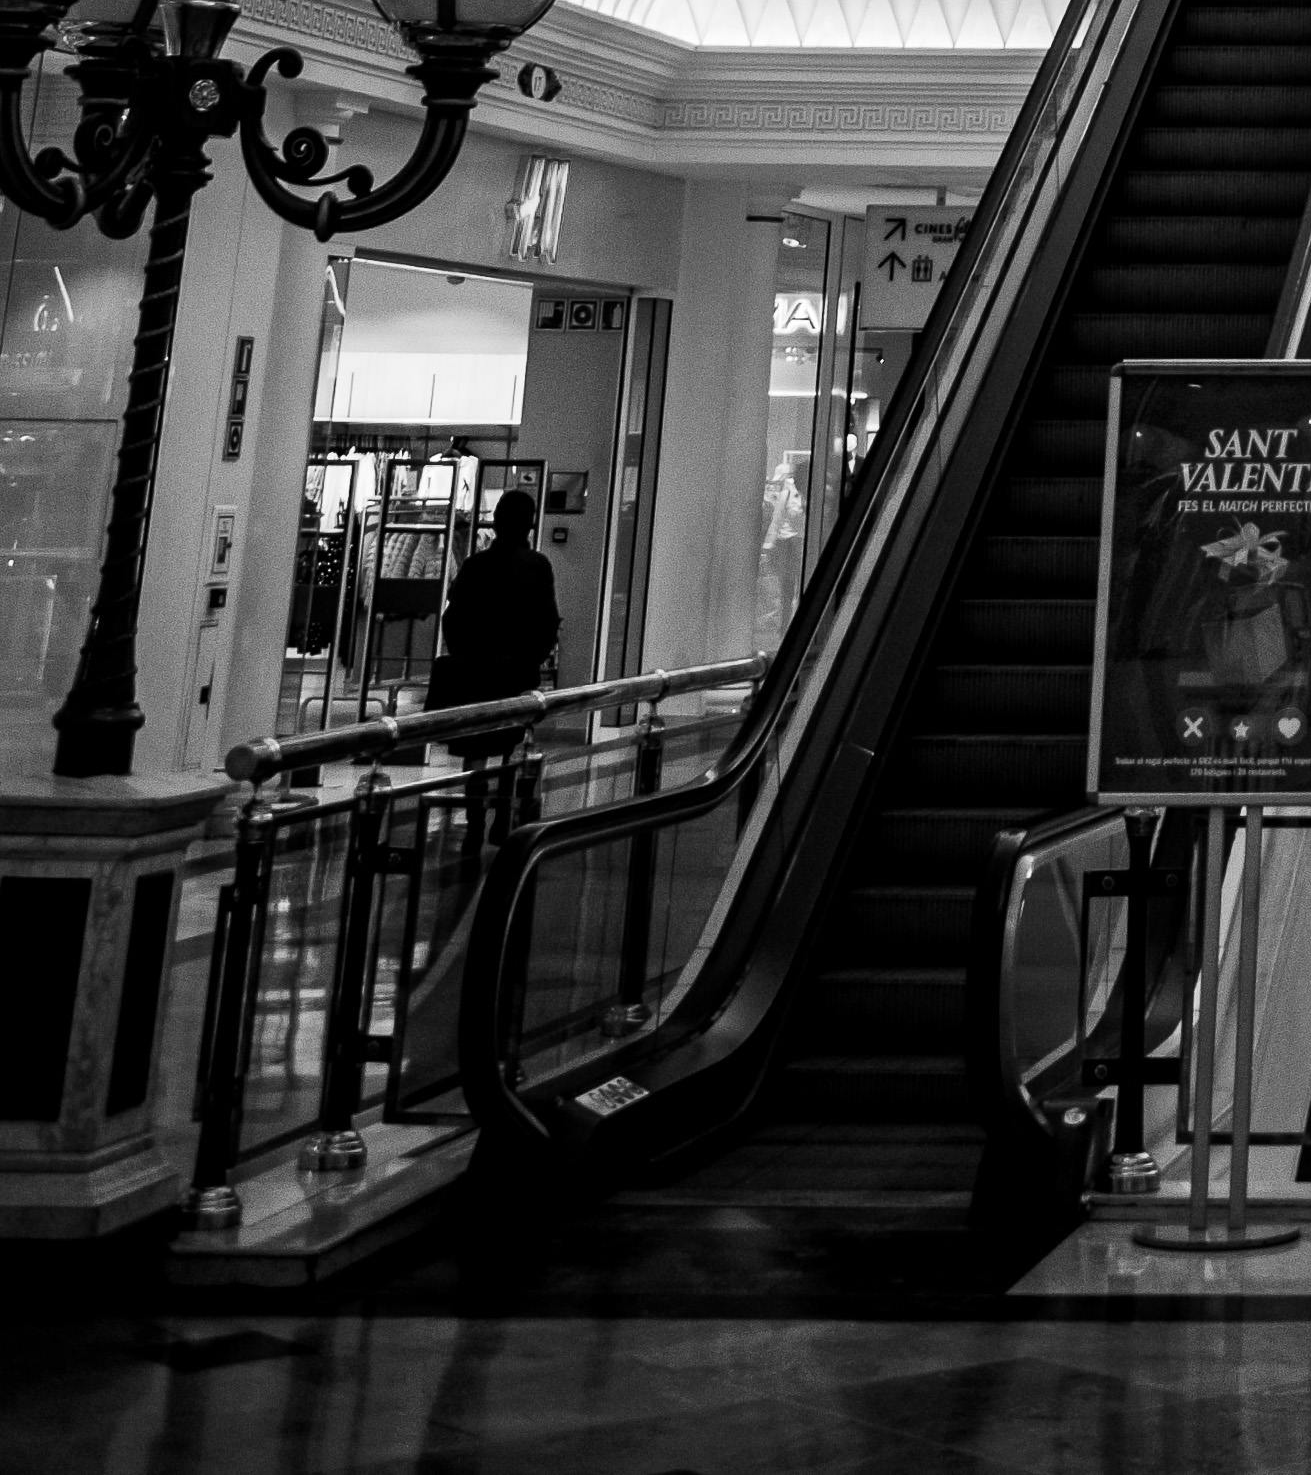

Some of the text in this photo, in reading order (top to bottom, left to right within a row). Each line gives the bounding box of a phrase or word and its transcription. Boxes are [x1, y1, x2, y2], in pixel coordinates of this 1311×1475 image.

[914, 223, 953, 235] CINES
[1205, 429, 1298, 458] SANT
[1178, 500, 1198, 512] FES
[1202, 500, 1216, 512] EL
[1218, 500, 1259, 512] MATCH
